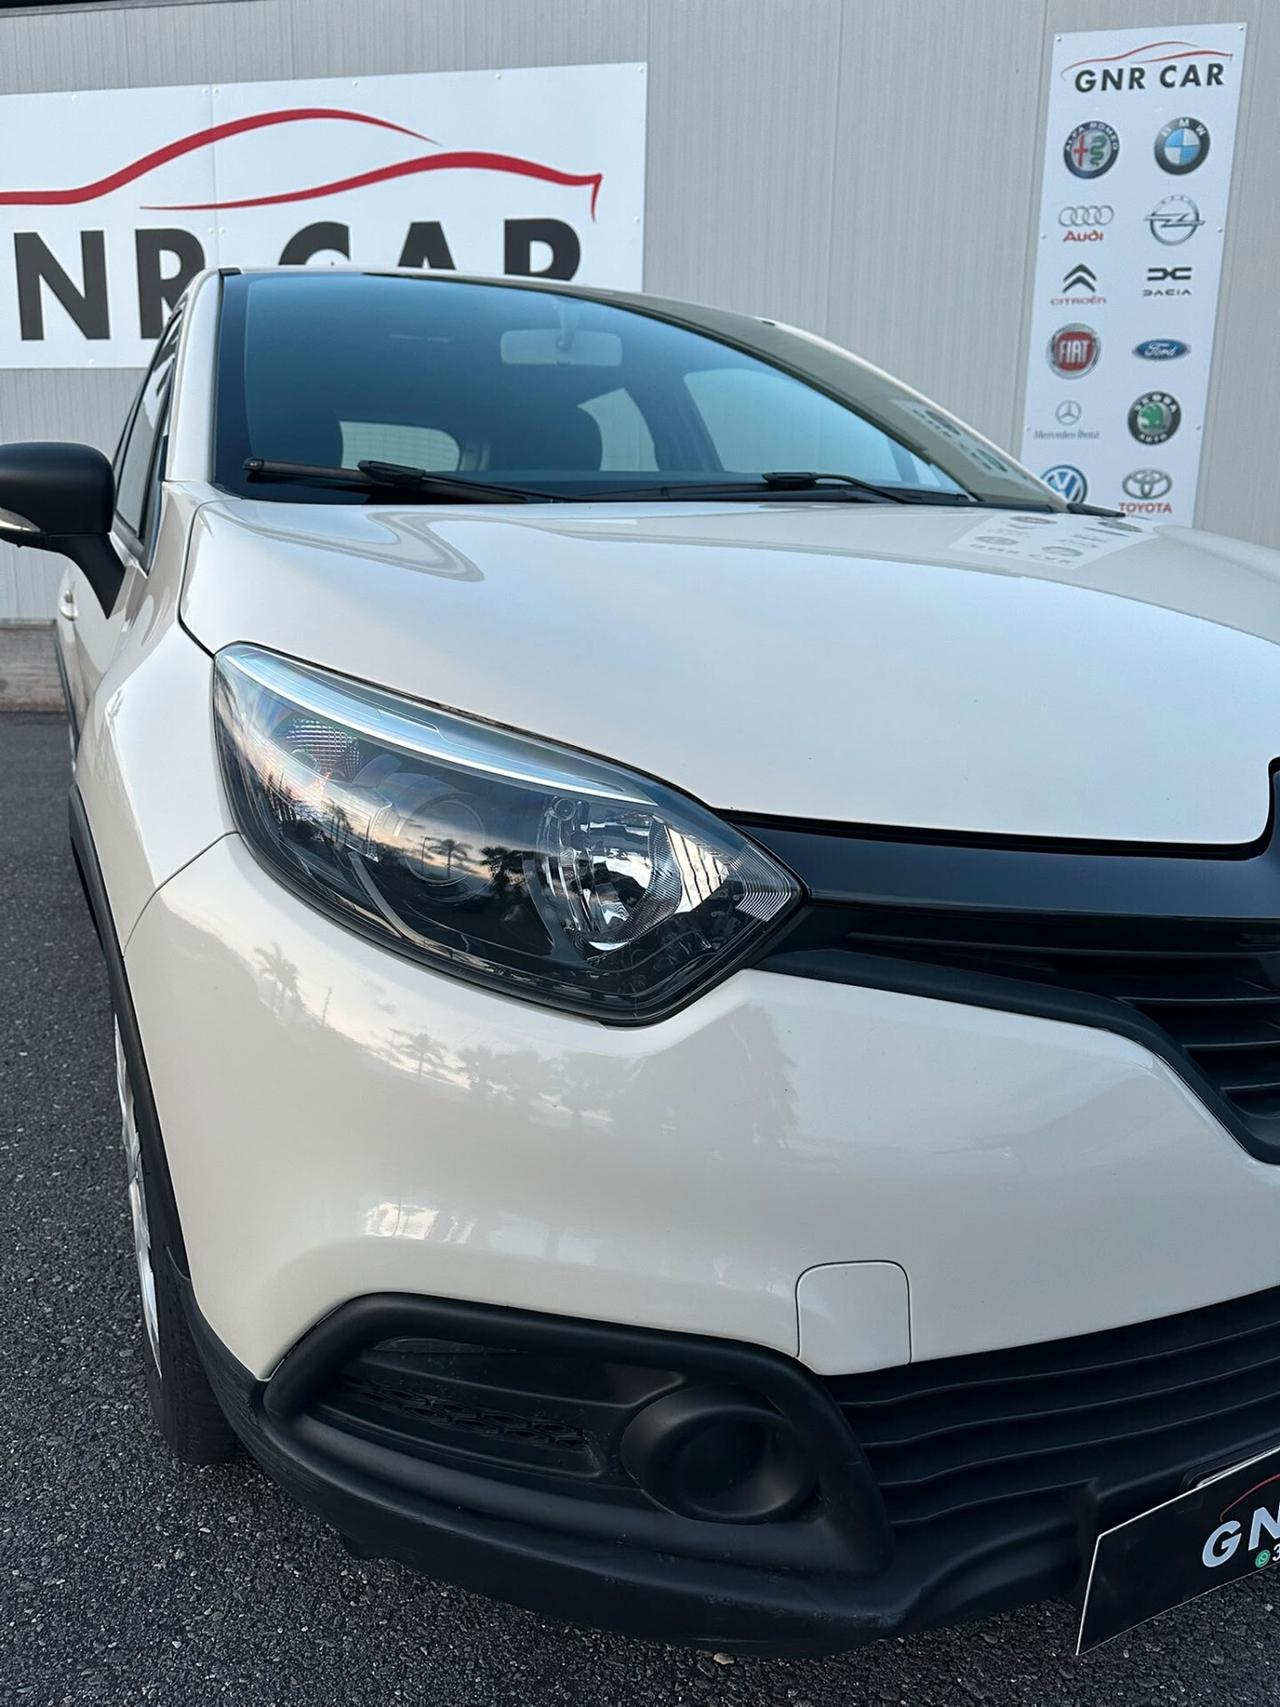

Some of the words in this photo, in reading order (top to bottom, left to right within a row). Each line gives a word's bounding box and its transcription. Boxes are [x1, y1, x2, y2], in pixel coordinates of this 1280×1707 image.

[1075, 67, 1146, 93] GNR
[1159, 62, 1225, 89] CAR
[1160, 118, 1207, 137] BMW
[1063, 229, 1104, 242] Audi
[1142, 288, 1192, 297] DACIA
[1059, 340, 1090, 363] FIAT
[1144, 342, 1178, 356] Ford
[1119, 502, 1173, 514] TOYOTA
